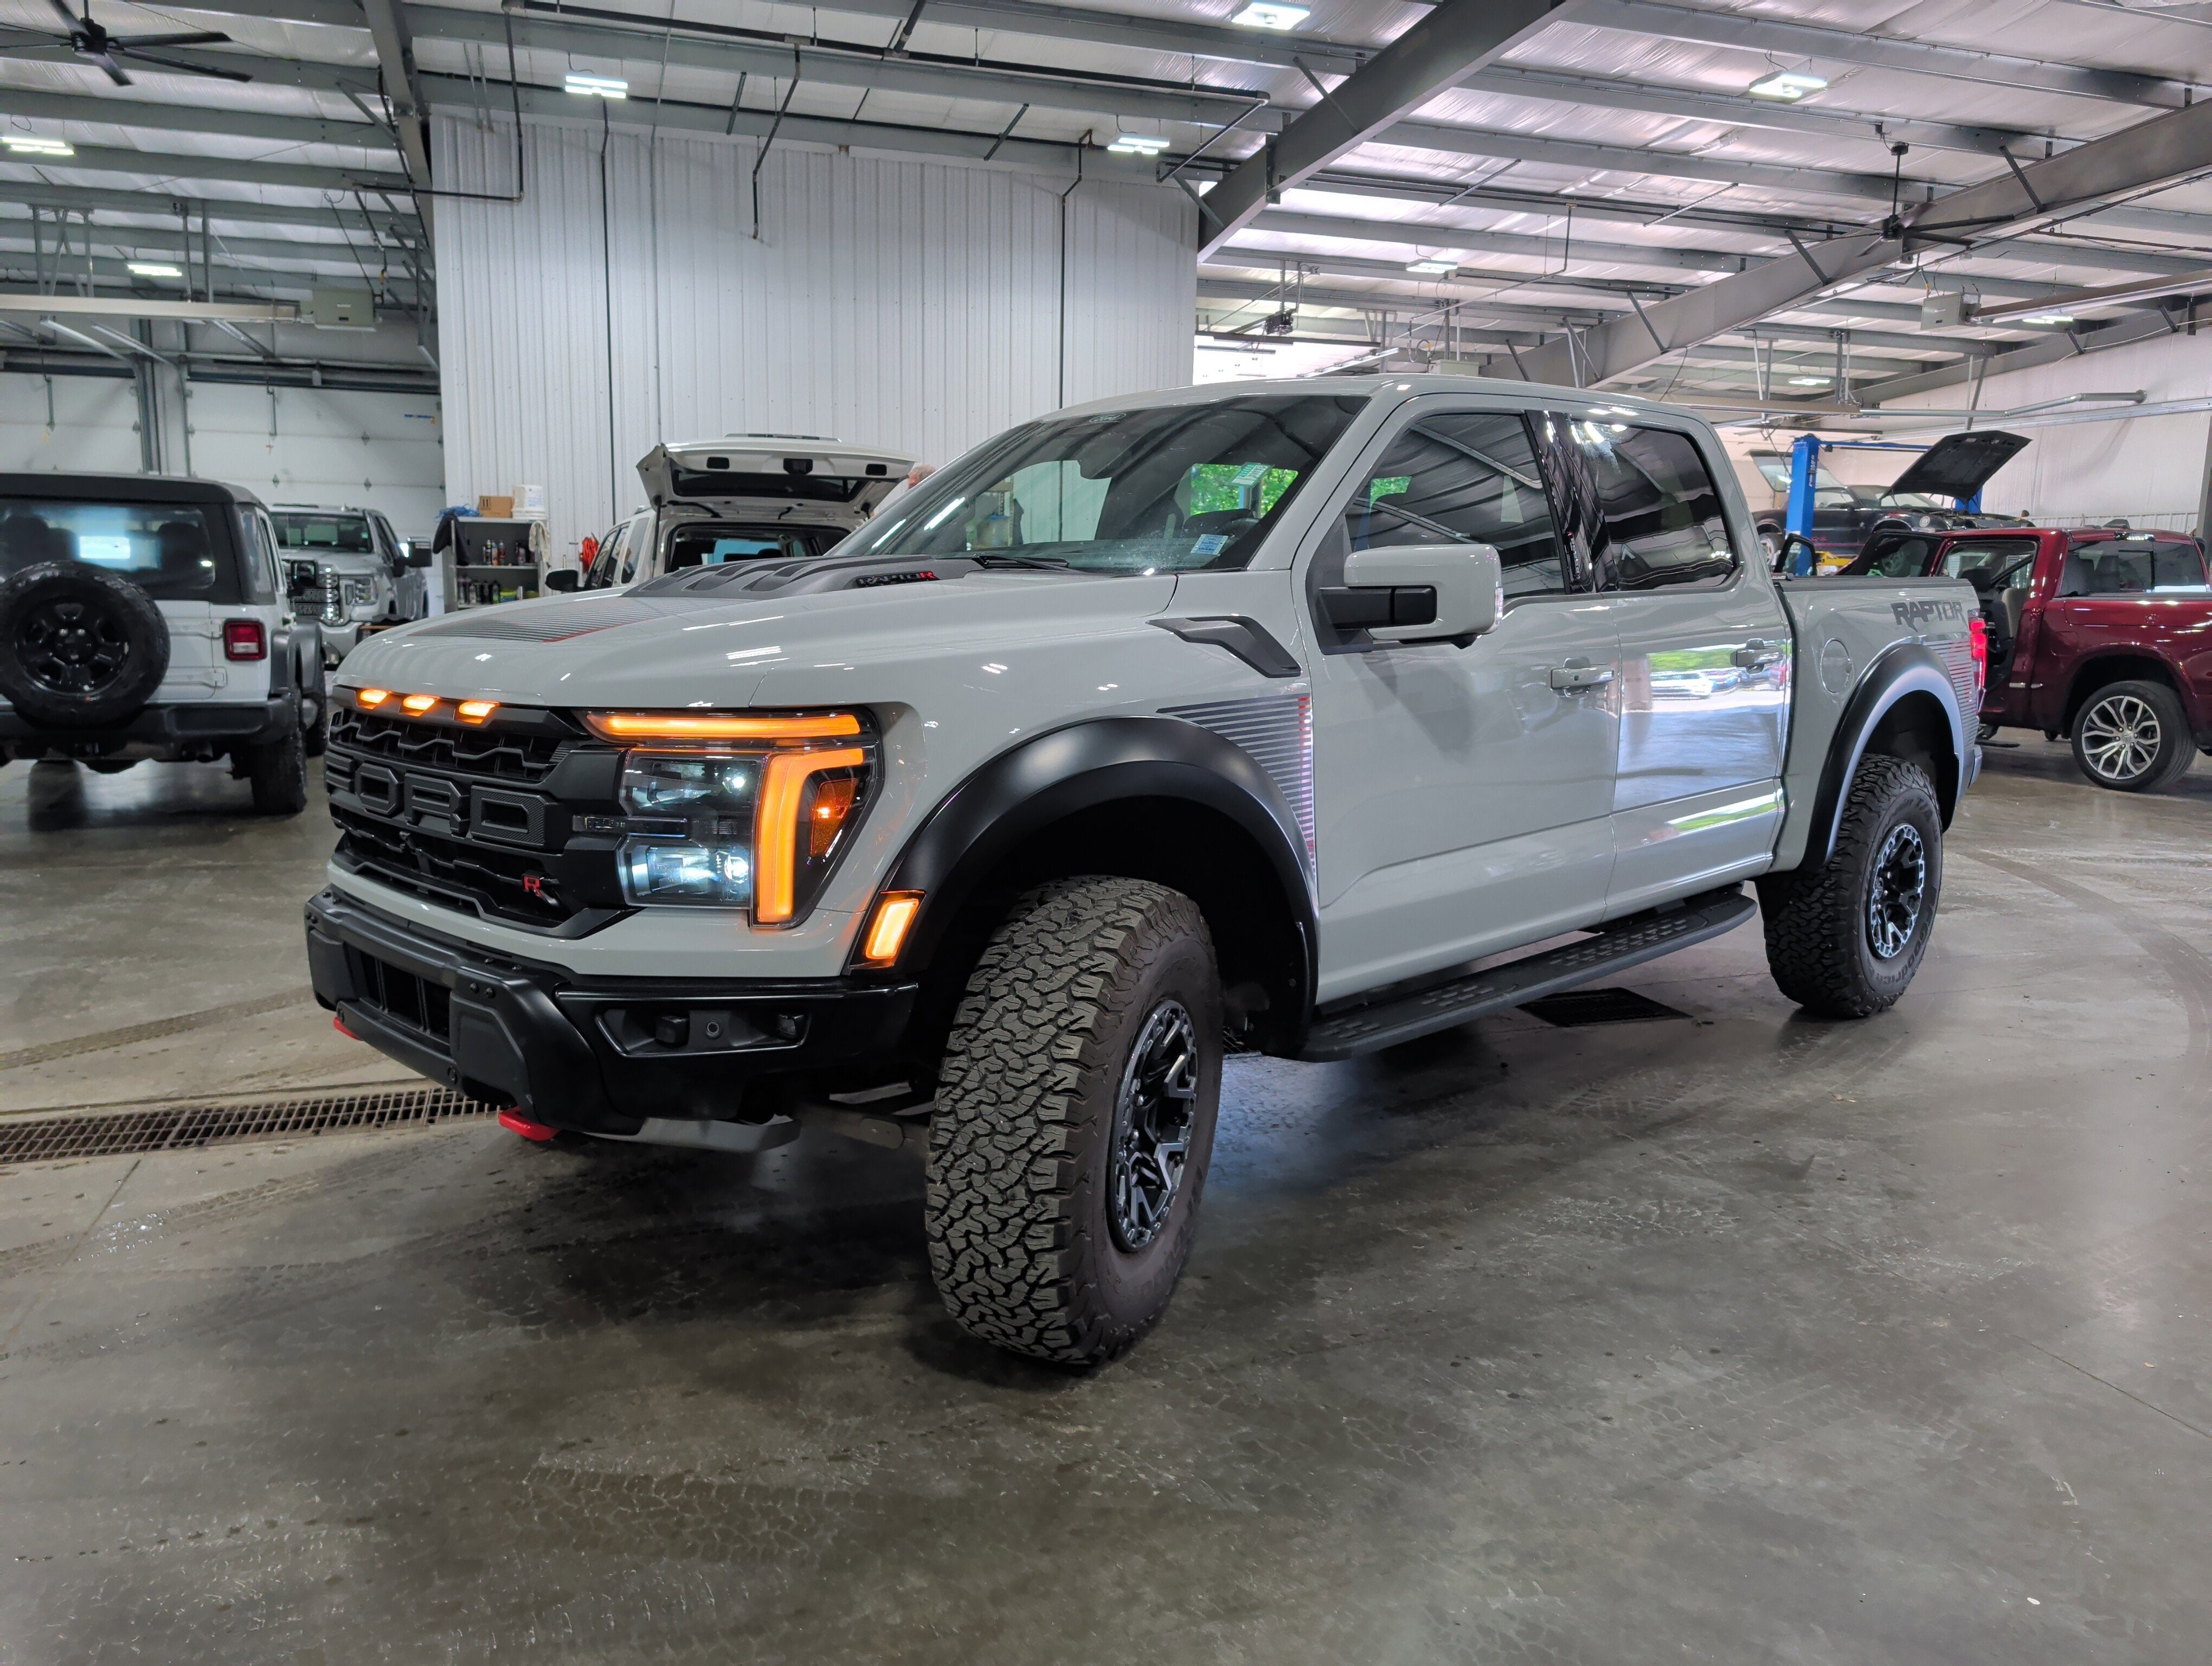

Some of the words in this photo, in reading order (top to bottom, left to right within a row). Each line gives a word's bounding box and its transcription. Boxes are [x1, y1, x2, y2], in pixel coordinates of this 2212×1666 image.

[1891, 600, 1969, 632] RAPTOR
[324, 750, 546, 846] FORD
[523, 874, 544, 900] R
